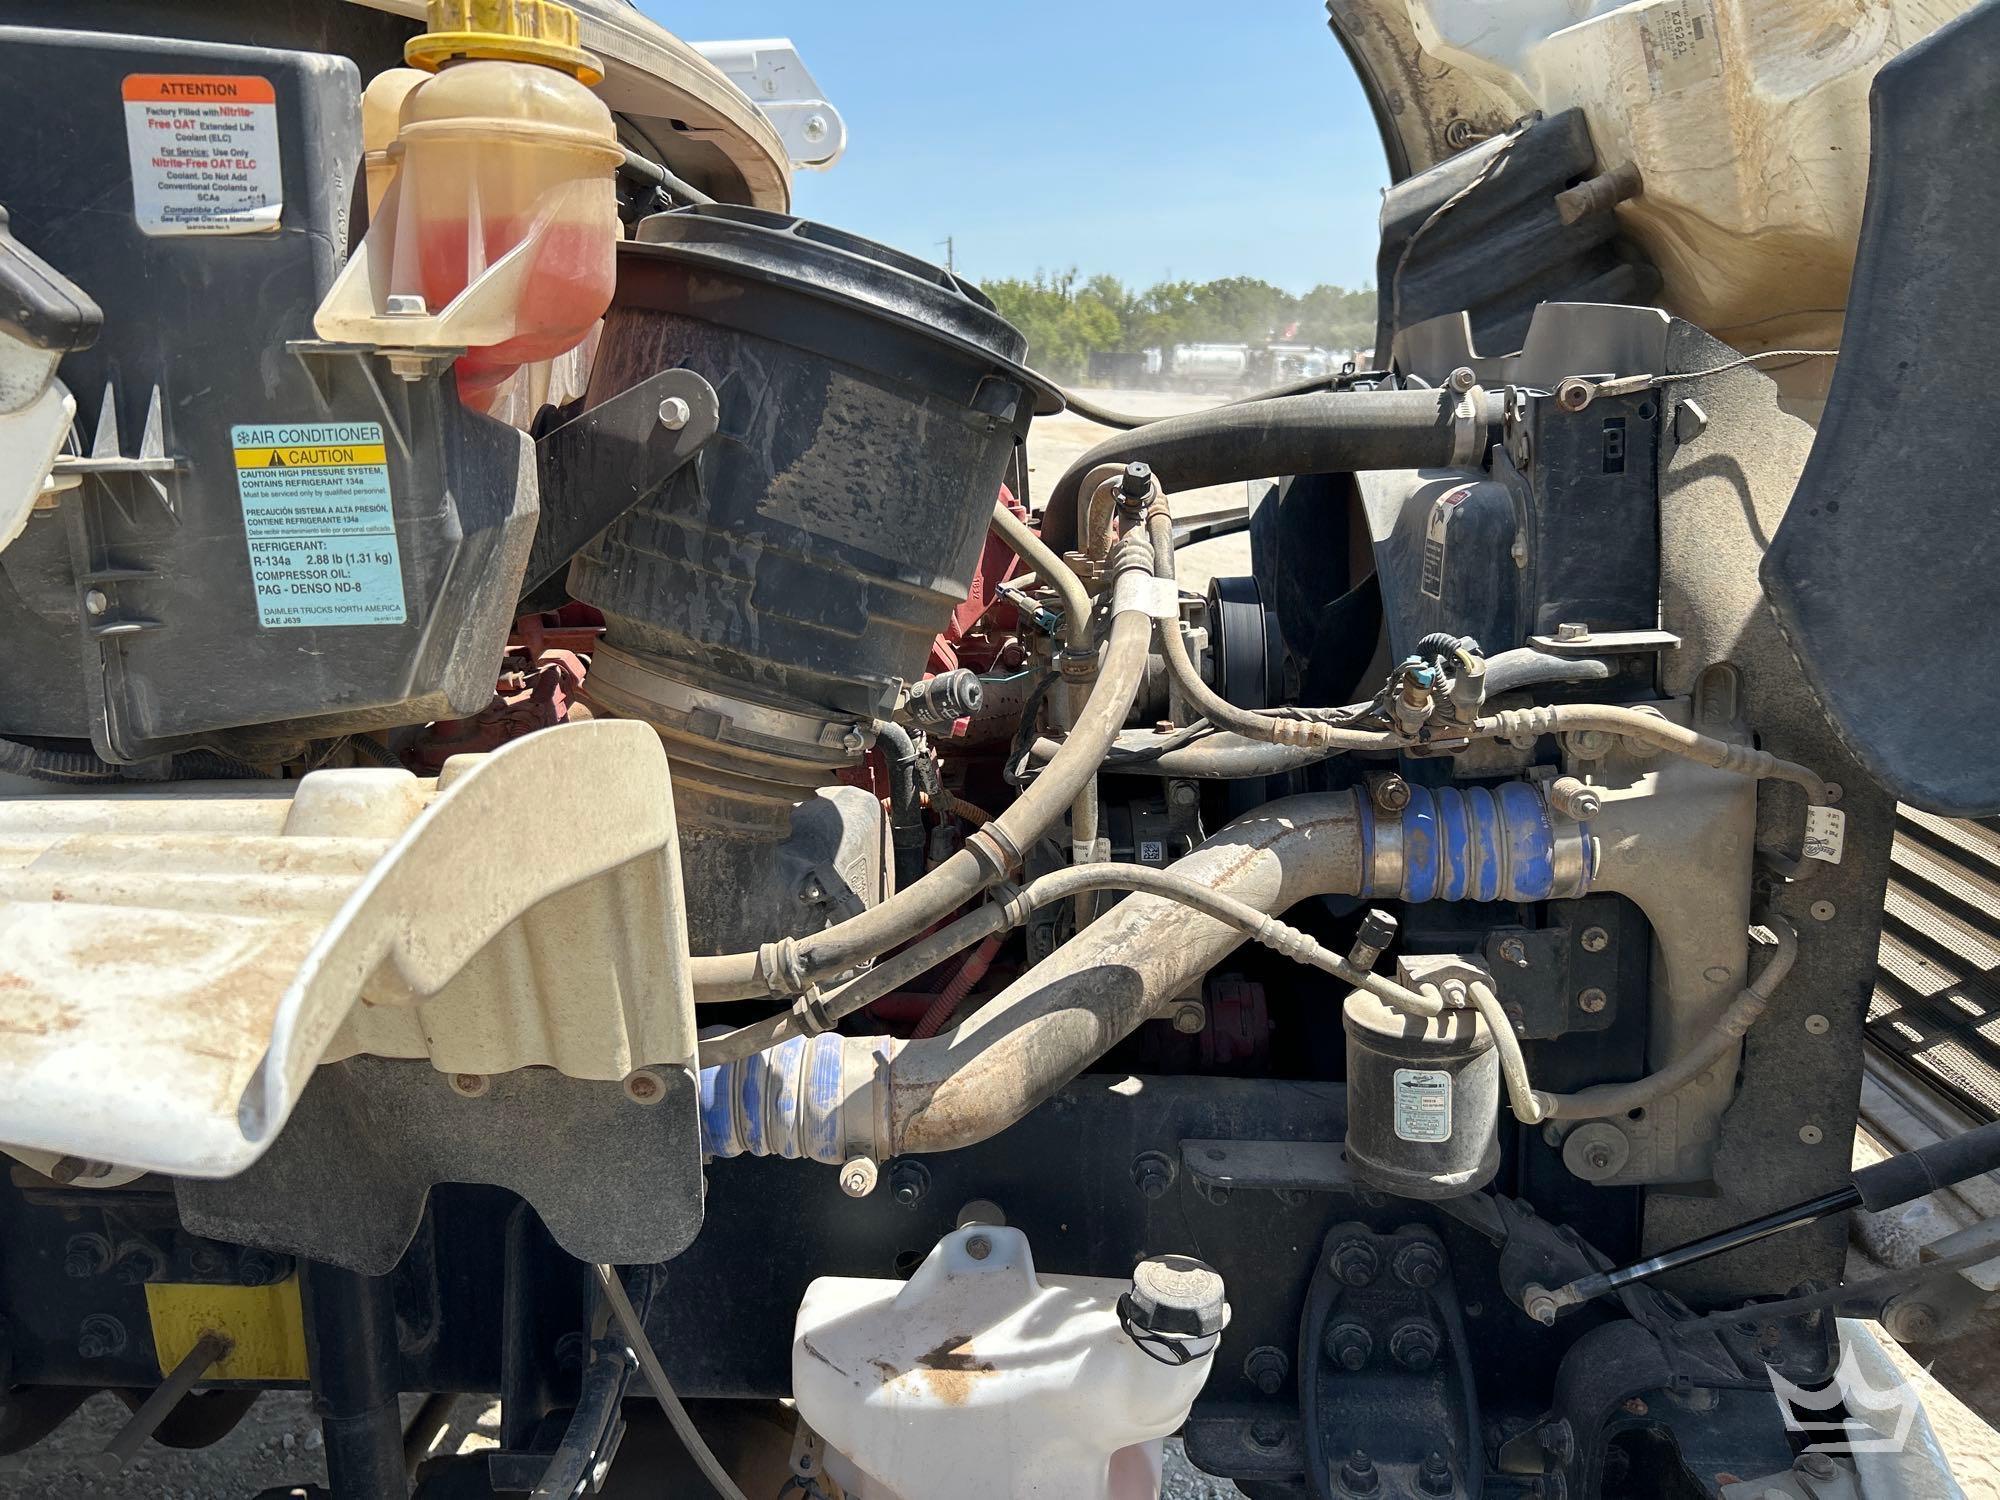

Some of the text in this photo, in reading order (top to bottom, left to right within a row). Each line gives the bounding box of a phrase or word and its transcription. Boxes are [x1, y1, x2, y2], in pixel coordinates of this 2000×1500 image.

[1671, 10, 1687, 55] KJ6261
[160, 84, 237, 96] ATTENTION
[146, 107, 254, 117] Factory Filled with Nitrite-
[148, 119, 255, 131] Free OAT Extended Life
[209, 134, 231, 143] (ELC)
[161, 147, 249, 158] For Service: Use Only
[152, 159, 256, 169] Nitrite-Free OAT ELC
[167, 172, 200, 180] Coolant.
[158, 182, 210, 190] Conventional
[163, 206, 211, 215] Compatible
[176, 215, 199, 223] Engine
[251, 427, 380, 444] AIR CONDITIONER
[289, 449, 354, 464] CAUTION
[242, 480, 283, 488] CONTAINS
[244, 490, 257, 498] Must
[325, 489, 352, 497] qualified
[246, 507, 293, 516] PRECAUCIÓN
[295, 507, 326, 515] SISTEMA
[355, 504, 388, 513] PRESIÓN,
[248, 518, 283, 526] CONTIENE
[285, 517, 342, 525] REFRIGERANTE
[251, 541, 327, 551] REFRIGERANT:
[254, 552, 393, 566] R-134a 2.88 lb (1.31 kg)
[256, 569, 350, 581] COMPRESSOR OIL:
[258, 584, 282, 595] PAG
[292, 583, 332, 594] DENSO
[335, 582, 362, 592] ND-8
[264, 604, 400, 615] DAIMLER TRUCKS NORTH AMERICA
[265, 617, 282, 625] SAE
